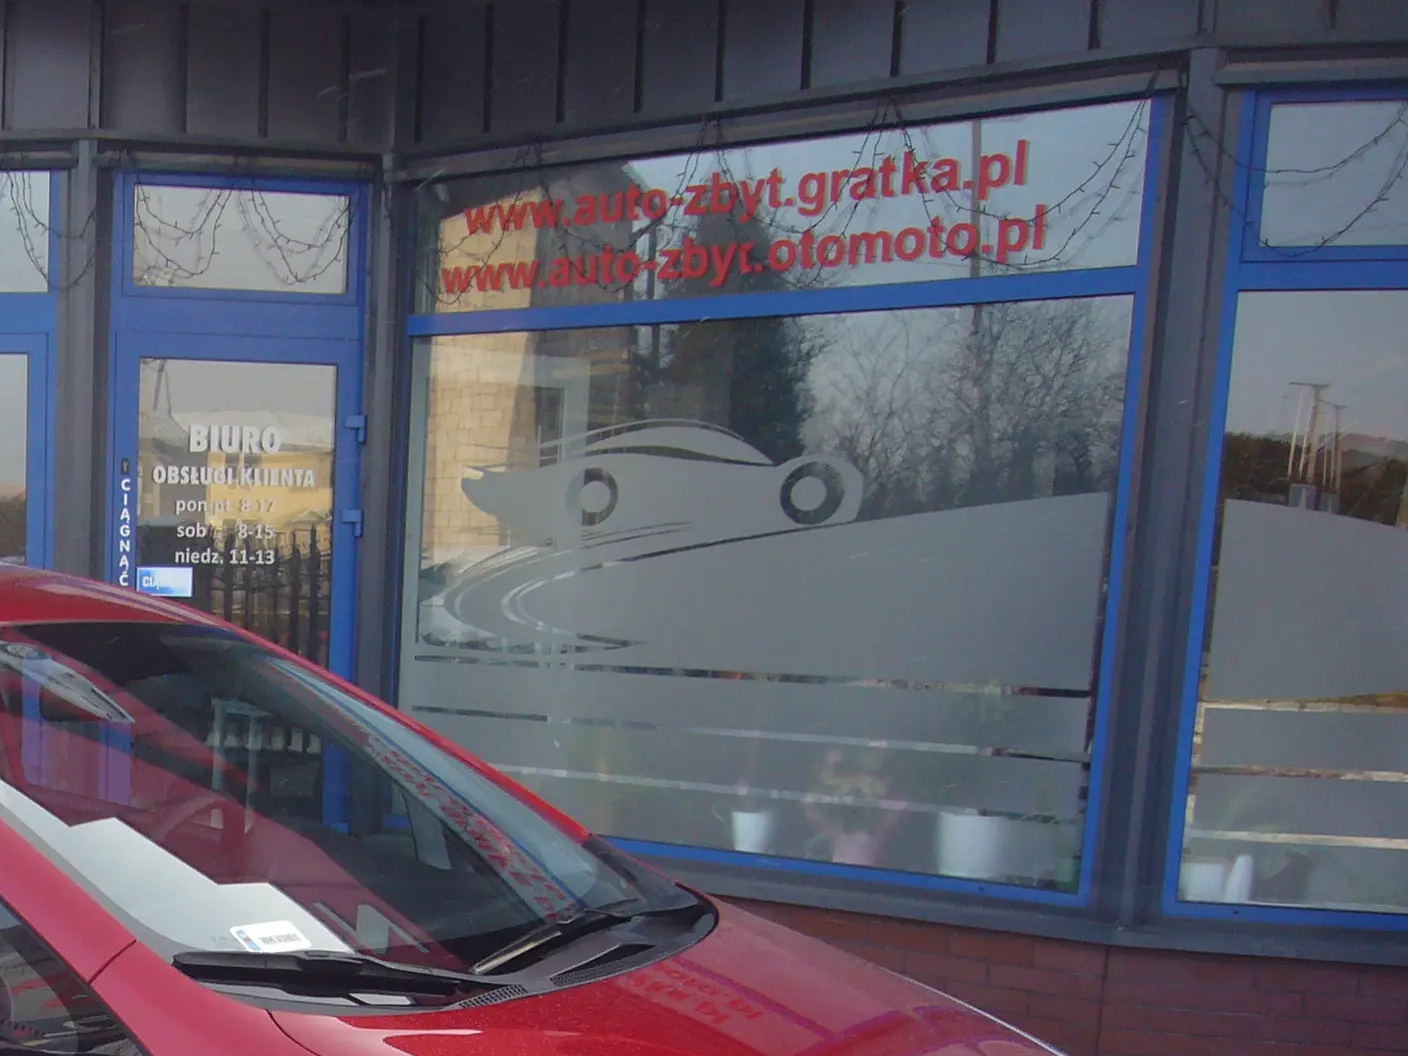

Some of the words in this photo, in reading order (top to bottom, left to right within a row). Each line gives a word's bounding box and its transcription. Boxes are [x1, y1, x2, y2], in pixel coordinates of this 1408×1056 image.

[464, 139, 1029, 235] www.auto-zbyt.gratka.pl
[442, 204, 1046, 294] www.auto-zbyt.otomoto.pl
[189, 424, 282, 453] BIURO
[152, 465, 233, 486] OBSŁUGI
[240, 469, 316, 487] KLIENTA
[119, 479, 131, 587] CIĄGNĄĆ
[237, 524, 276, 539] 8-15
[175, 547, 224, 564] niedz.
[229, 549, 275, 564] 11-13
